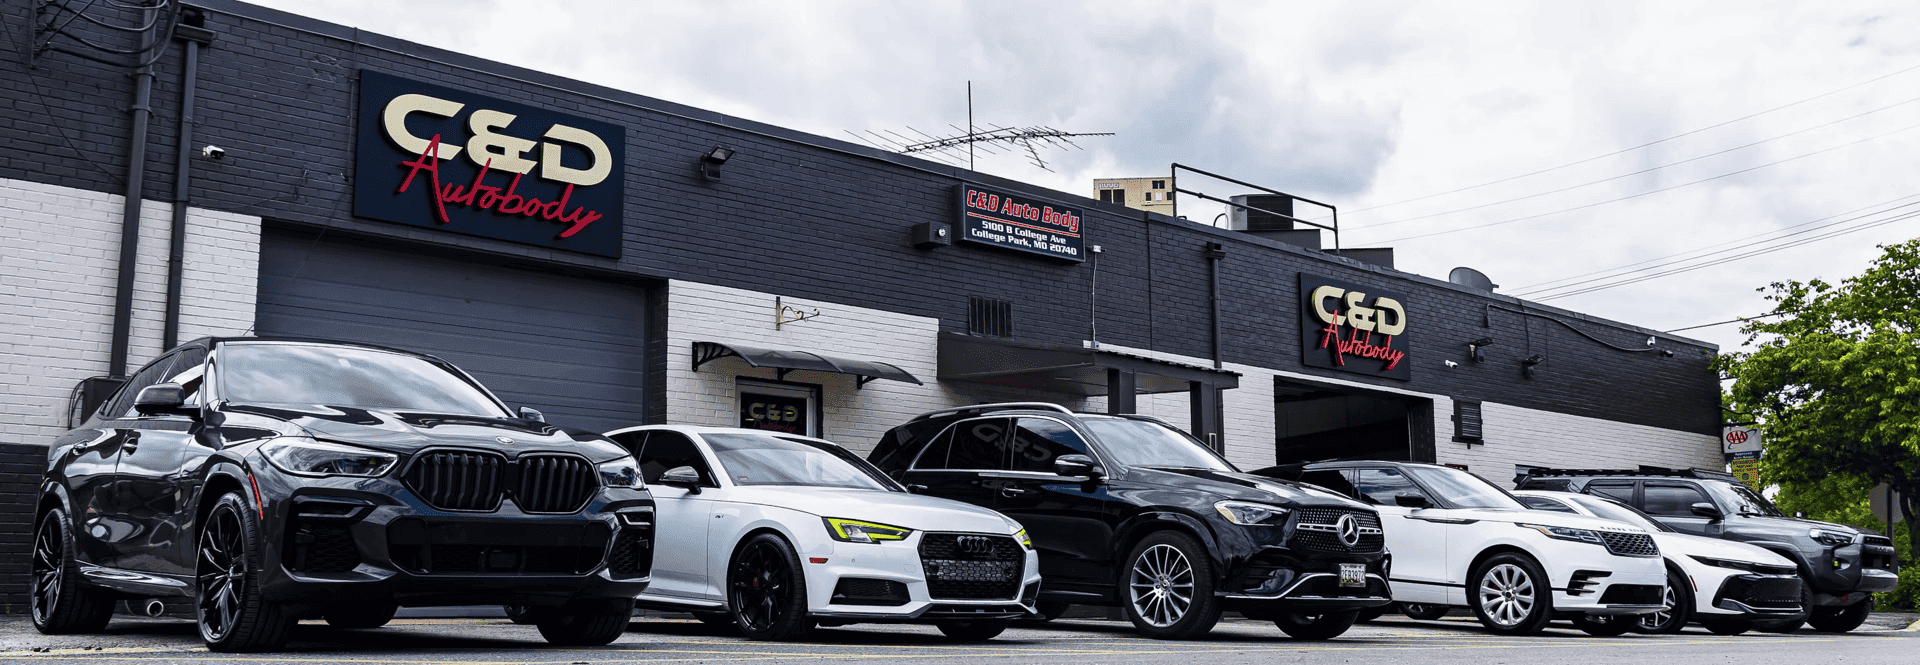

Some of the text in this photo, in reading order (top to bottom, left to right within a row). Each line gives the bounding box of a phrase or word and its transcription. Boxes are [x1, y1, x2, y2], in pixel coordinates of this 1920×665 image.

[383, 93, 612, 186] C&D
[397, 133, 602, 238] Autobody
[967, 190, 1080, 232] C&D Auto Body
[971, 228, 1077, 255] College Park, MD 20740
[982, 220, 1067, 245] 5100 B College Ave
[1311, 285, 1406, 336] C&D
[1321, 309, 1405, 370] Autobody
[749, 403, 798, 421] C&D
[1726, 431, 1748, 444] AAA
